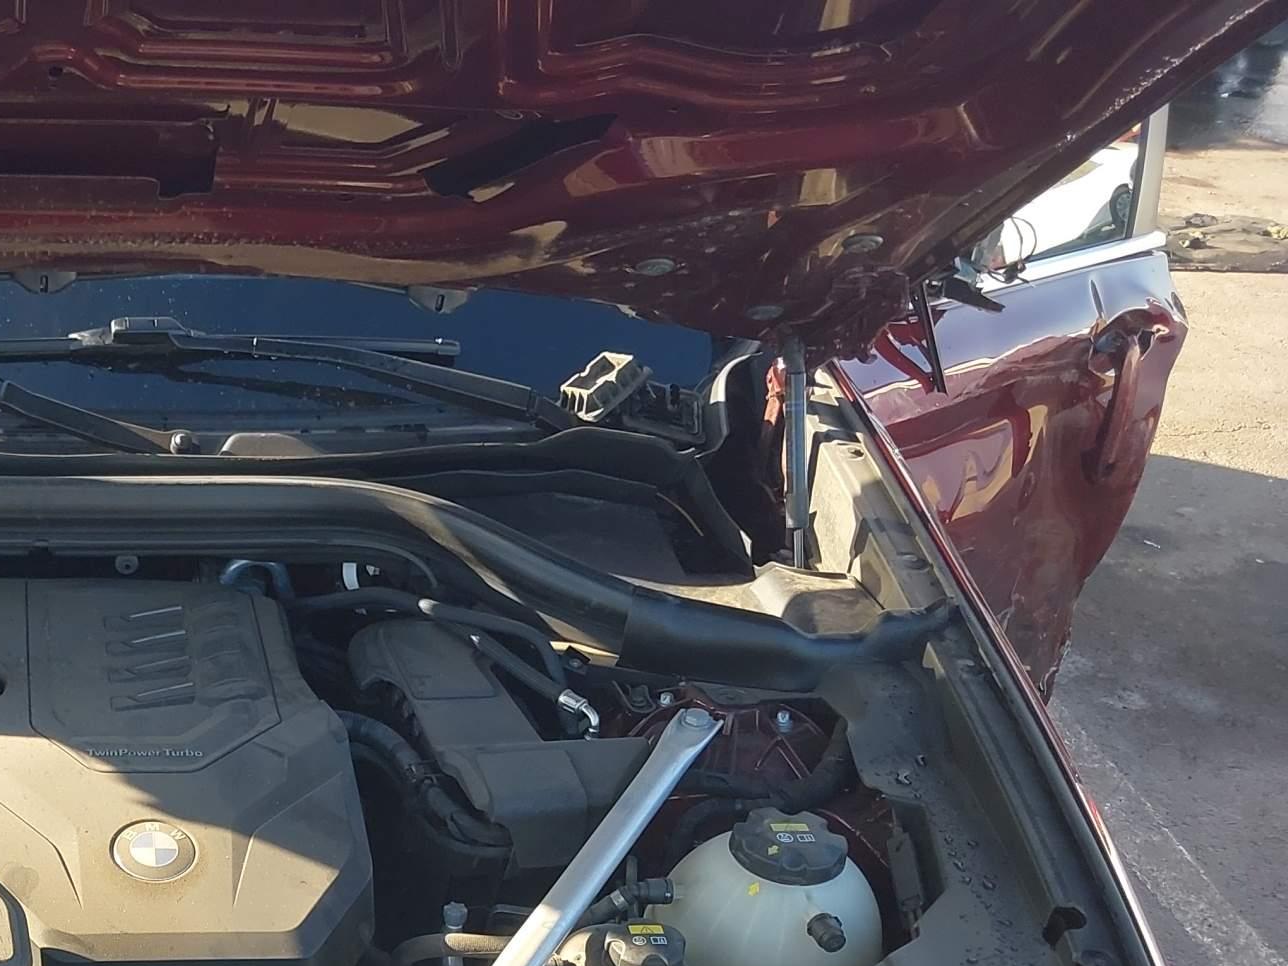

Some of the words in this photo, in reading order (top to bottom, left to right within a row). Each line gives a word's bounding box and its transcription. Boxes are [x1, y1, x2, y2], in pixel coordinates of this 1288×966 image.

[88, 748, 159, 757] TwinPower
[163, 748, 203, 757] Turbo
[121, 822, 187, 841] BMW
